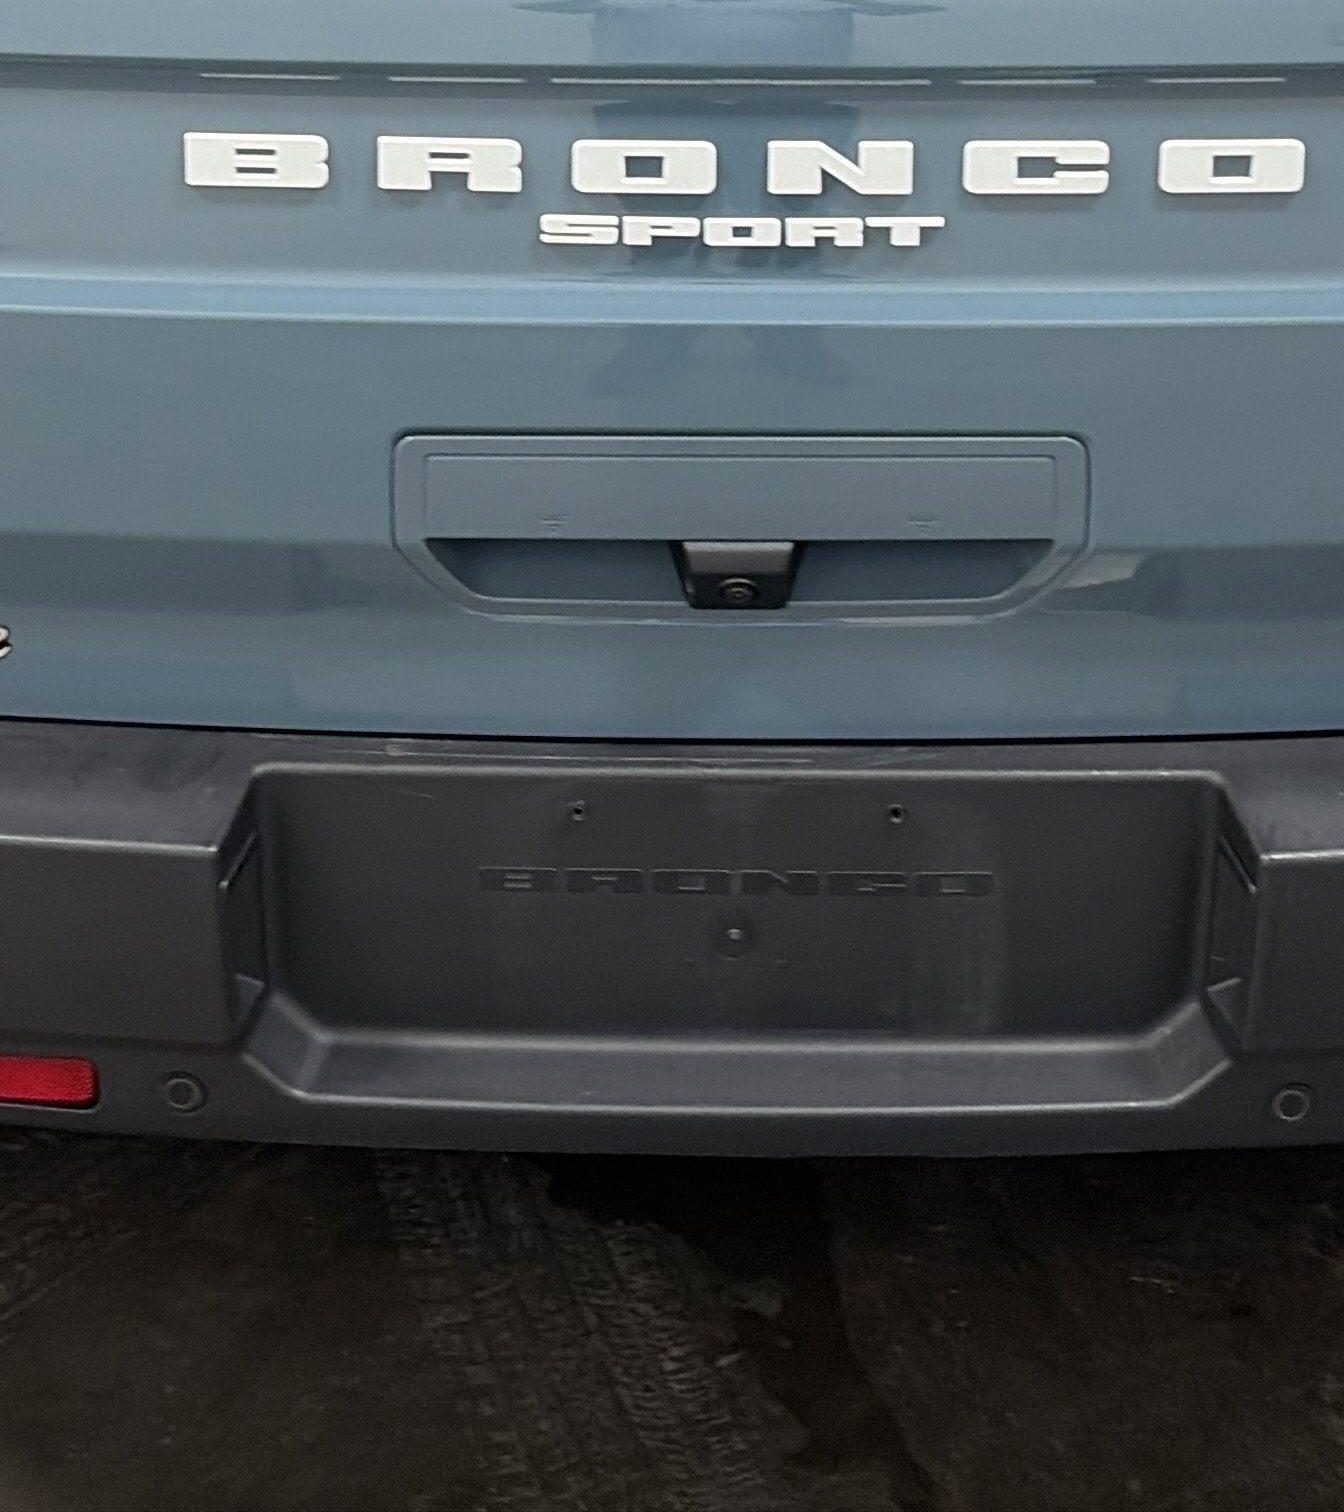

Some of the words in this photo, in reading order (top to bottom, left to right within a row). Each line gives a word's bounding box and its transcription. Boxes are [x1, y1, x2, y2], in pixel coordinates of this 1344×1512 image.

[183, 129, 1307, 196] BRONCO
[538, 213, 947, 248] SPORT
[477, 865, 996, 897] BRONCO
